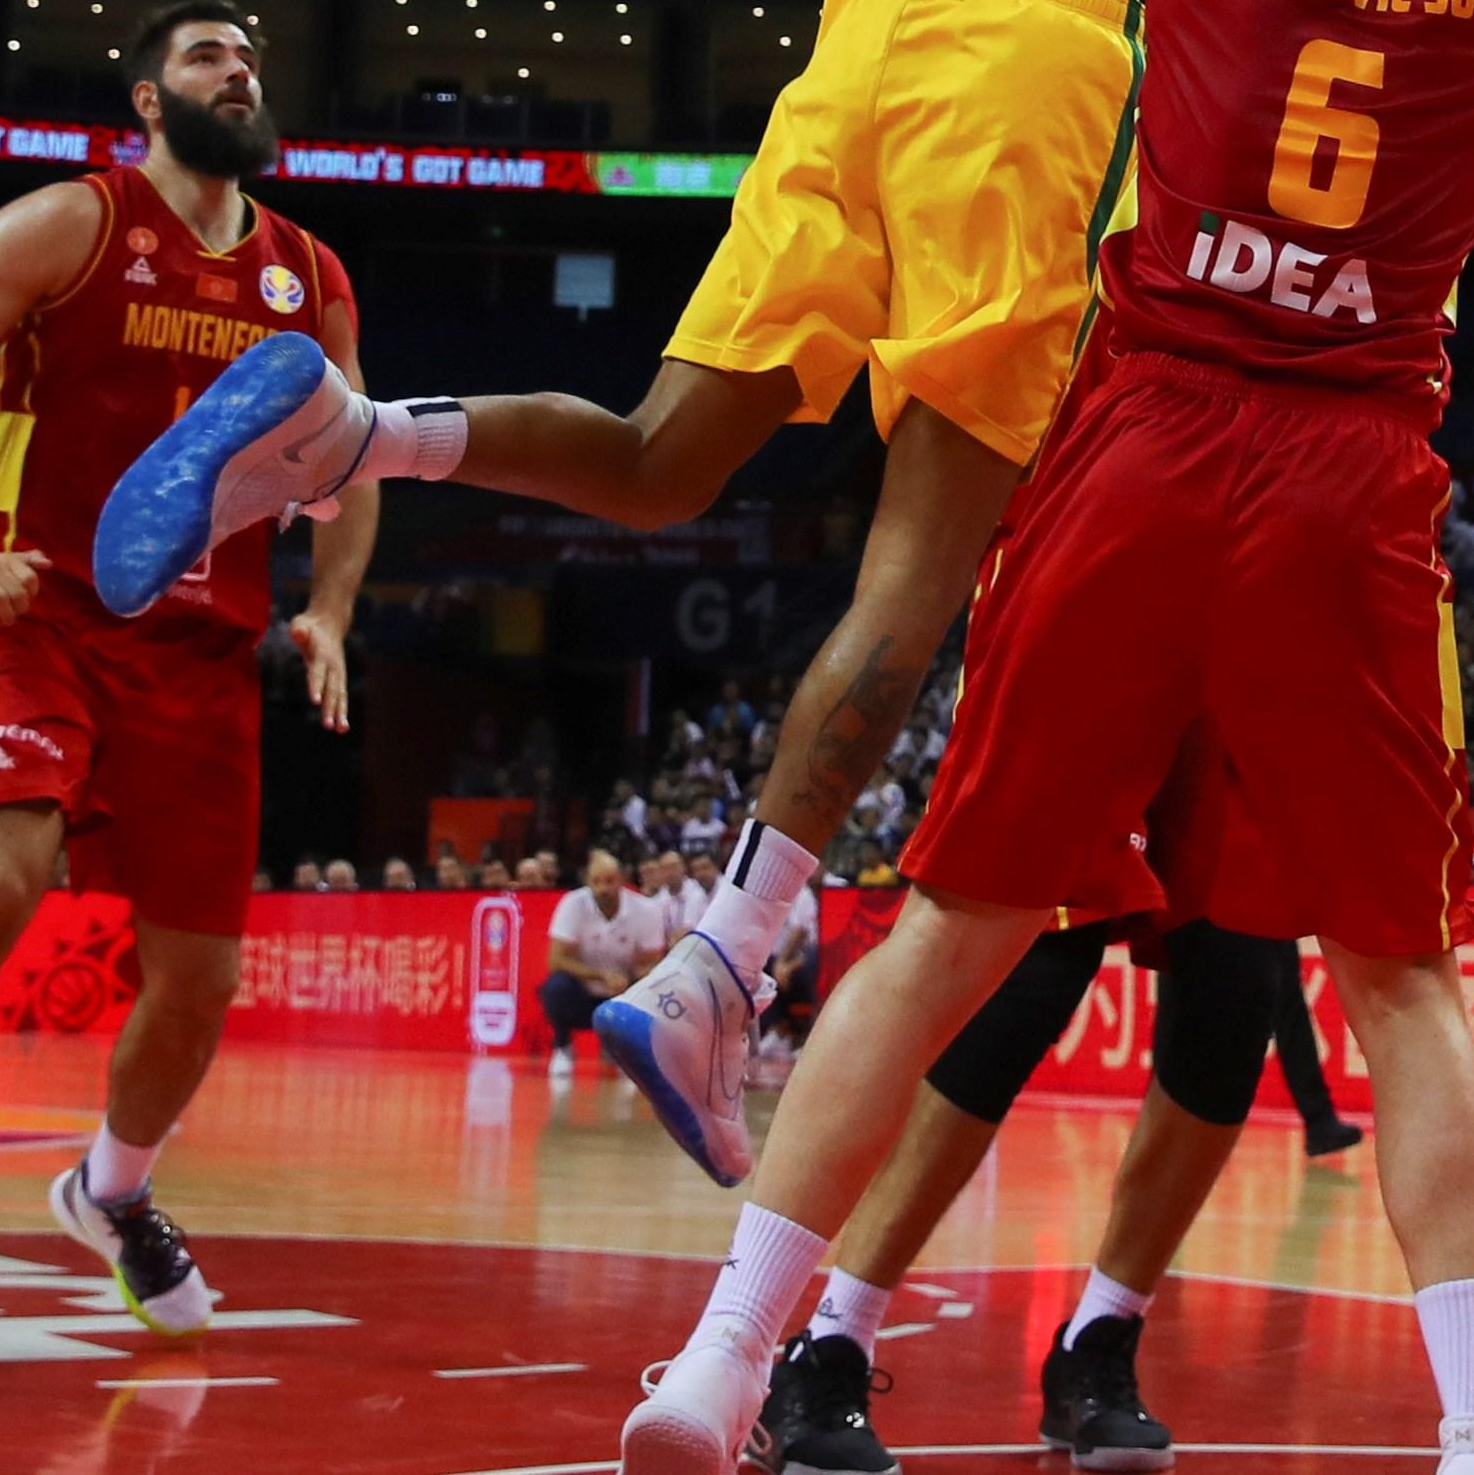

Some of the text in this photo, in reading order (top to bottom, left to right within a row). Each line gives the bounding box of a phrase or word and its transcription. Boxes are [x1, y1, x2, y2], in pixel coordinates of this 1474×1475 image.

[8, 126, 88, 162] GAME
[1267, 39, 1385, 230] 6
[285, 147, 545, 188] WORLD'S GOT GAME
